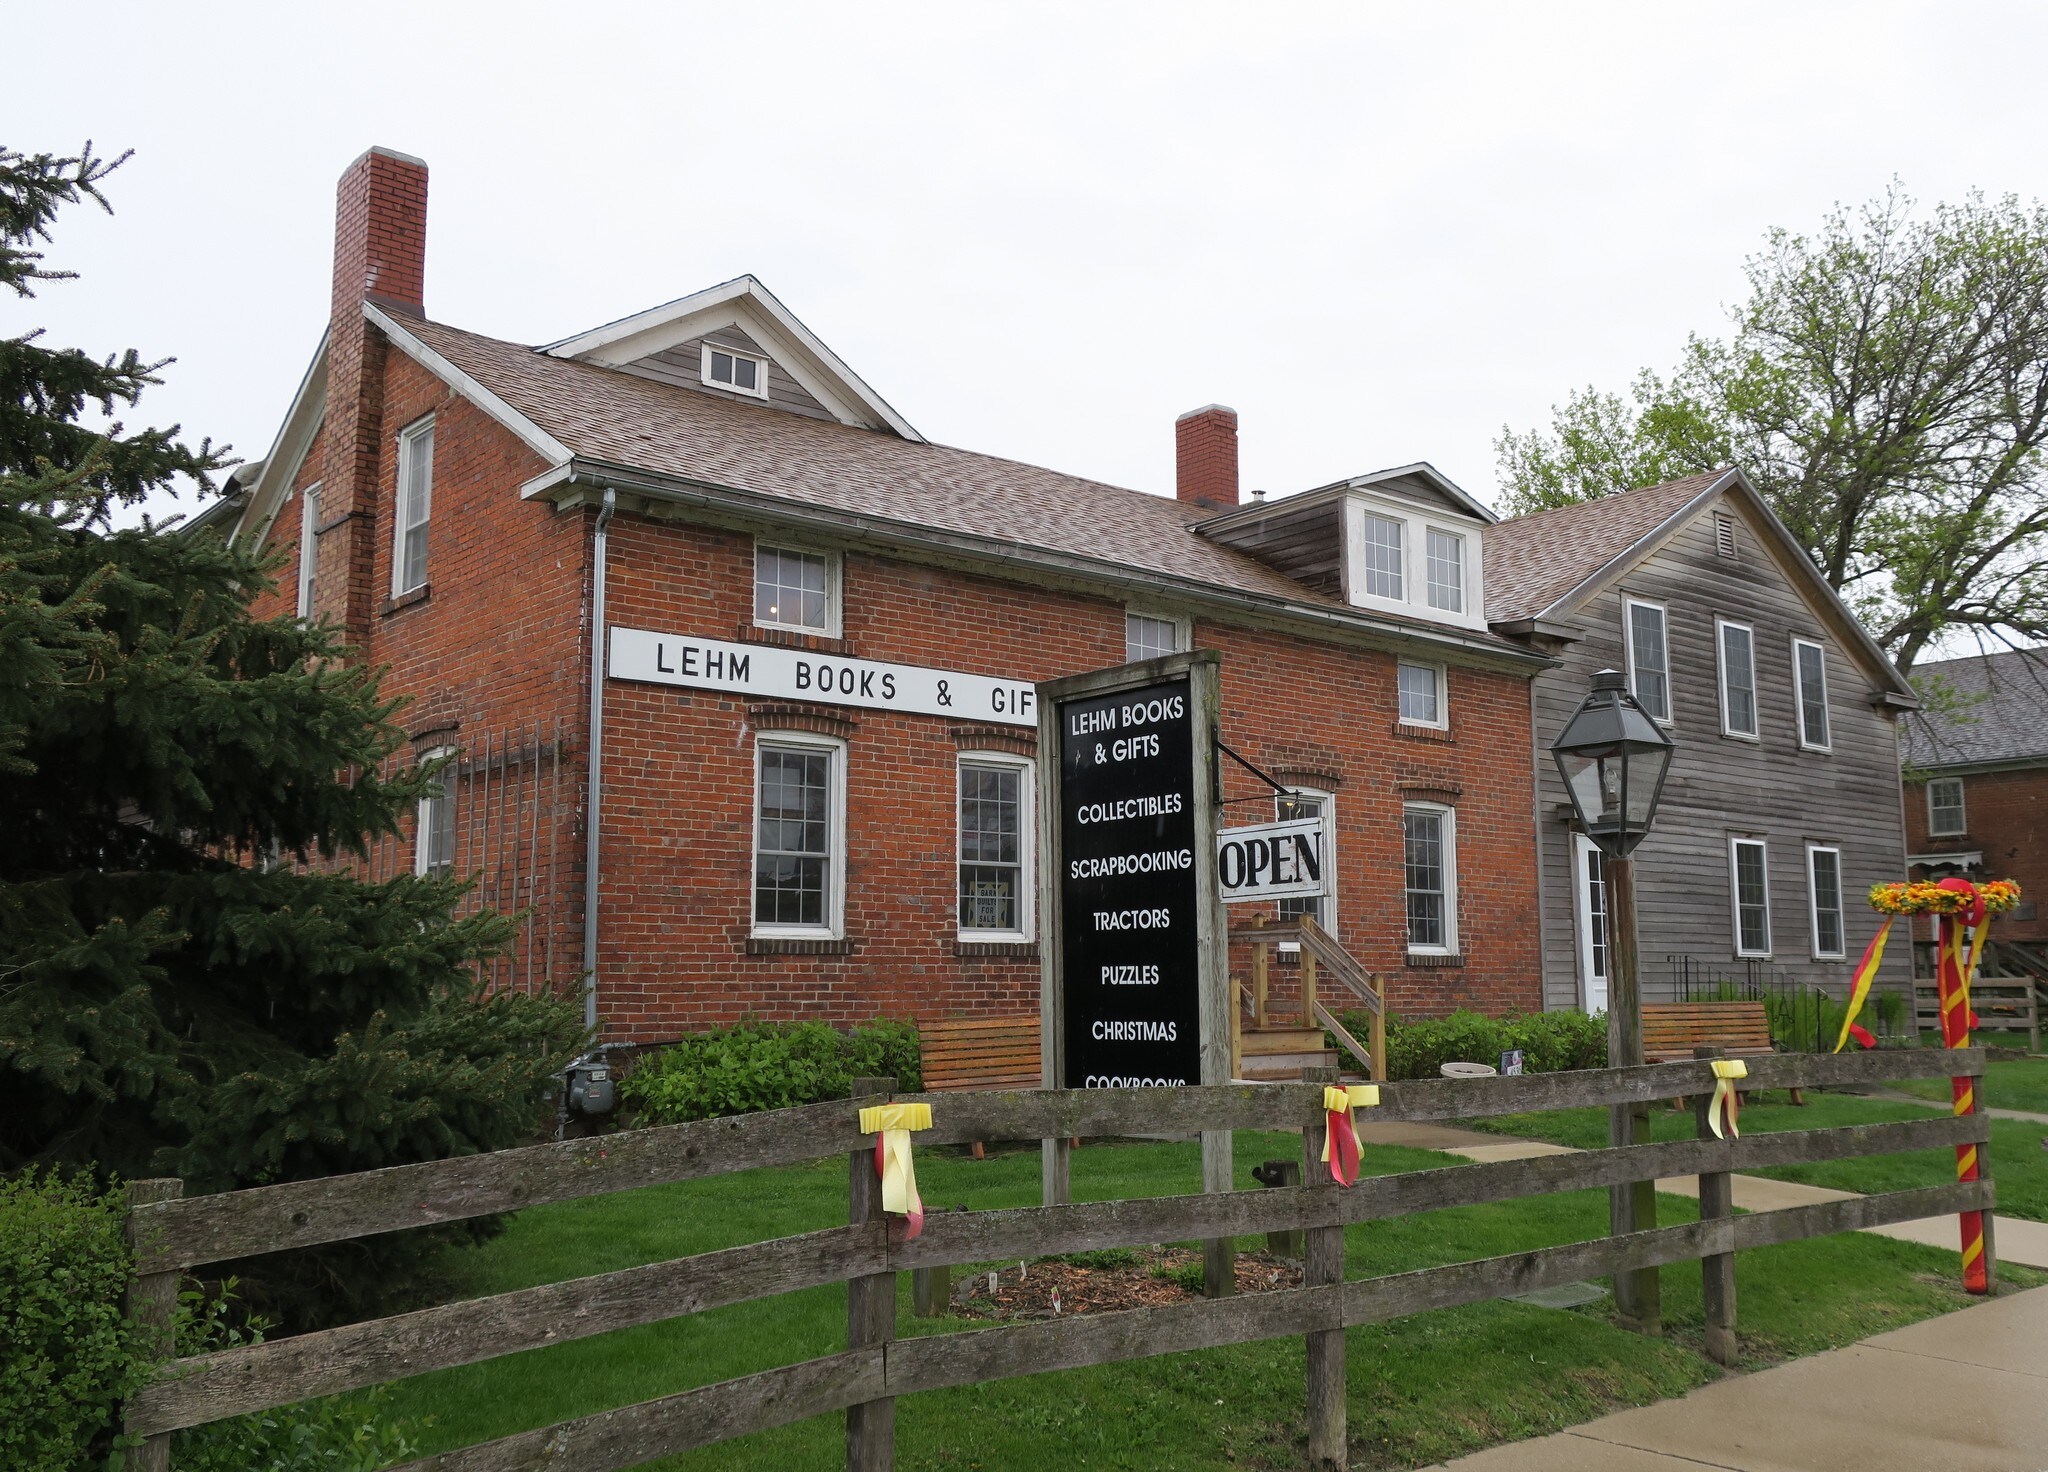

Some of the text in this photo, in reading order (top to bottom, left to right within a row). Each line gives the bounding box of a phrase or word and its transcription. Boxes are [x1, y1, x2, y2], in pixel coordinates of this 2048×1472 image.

[656, 642, 751, 684] LEHM
[795, 661, 897, 700] BOOKS
[937, 679, 953, 707] &
[1071, 695, 1184, 736] LEHM BOOKS
[1094, 733, 1160, 765] & GIFTS
[1077, 792, 1182, 825] COLLECTIBLES
[1071, 848, 1192, 880] SCRAPBOOKING
[1218, 832, 1322, 889] OPEN
[1093, 908, 1170, 931] TRACTORS
[1101, 965, 1160, 985] PUZZLES
[1092, 1020, 1177, 1042] CHRISTMAS
